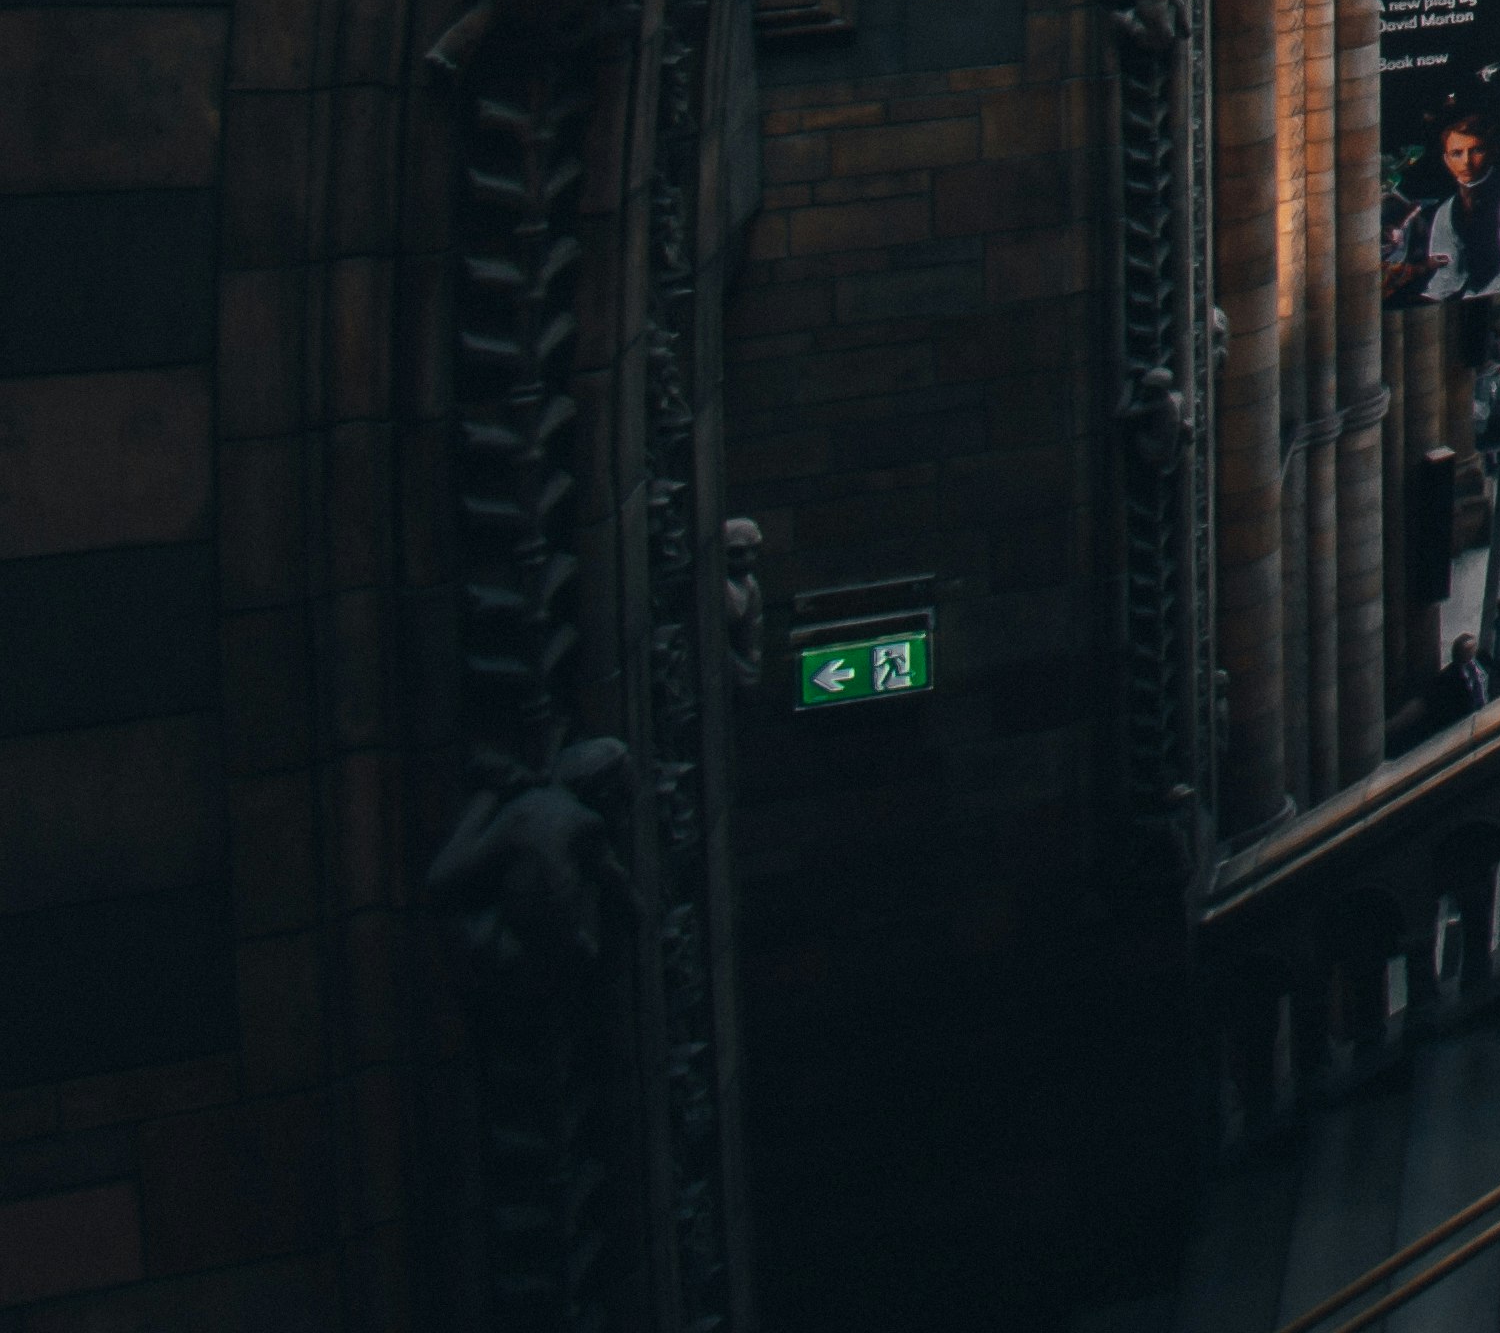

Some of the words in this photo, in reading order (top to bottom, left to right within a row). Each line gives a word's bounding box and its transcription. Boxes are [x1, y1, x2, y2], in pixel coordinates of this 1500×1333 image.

[1389, 0, 1420, 11] new
[1379, 15, 1417, 32] David
[1421, 12, 1473, 27] Morton
[1416, 53, 1448, 66] now
